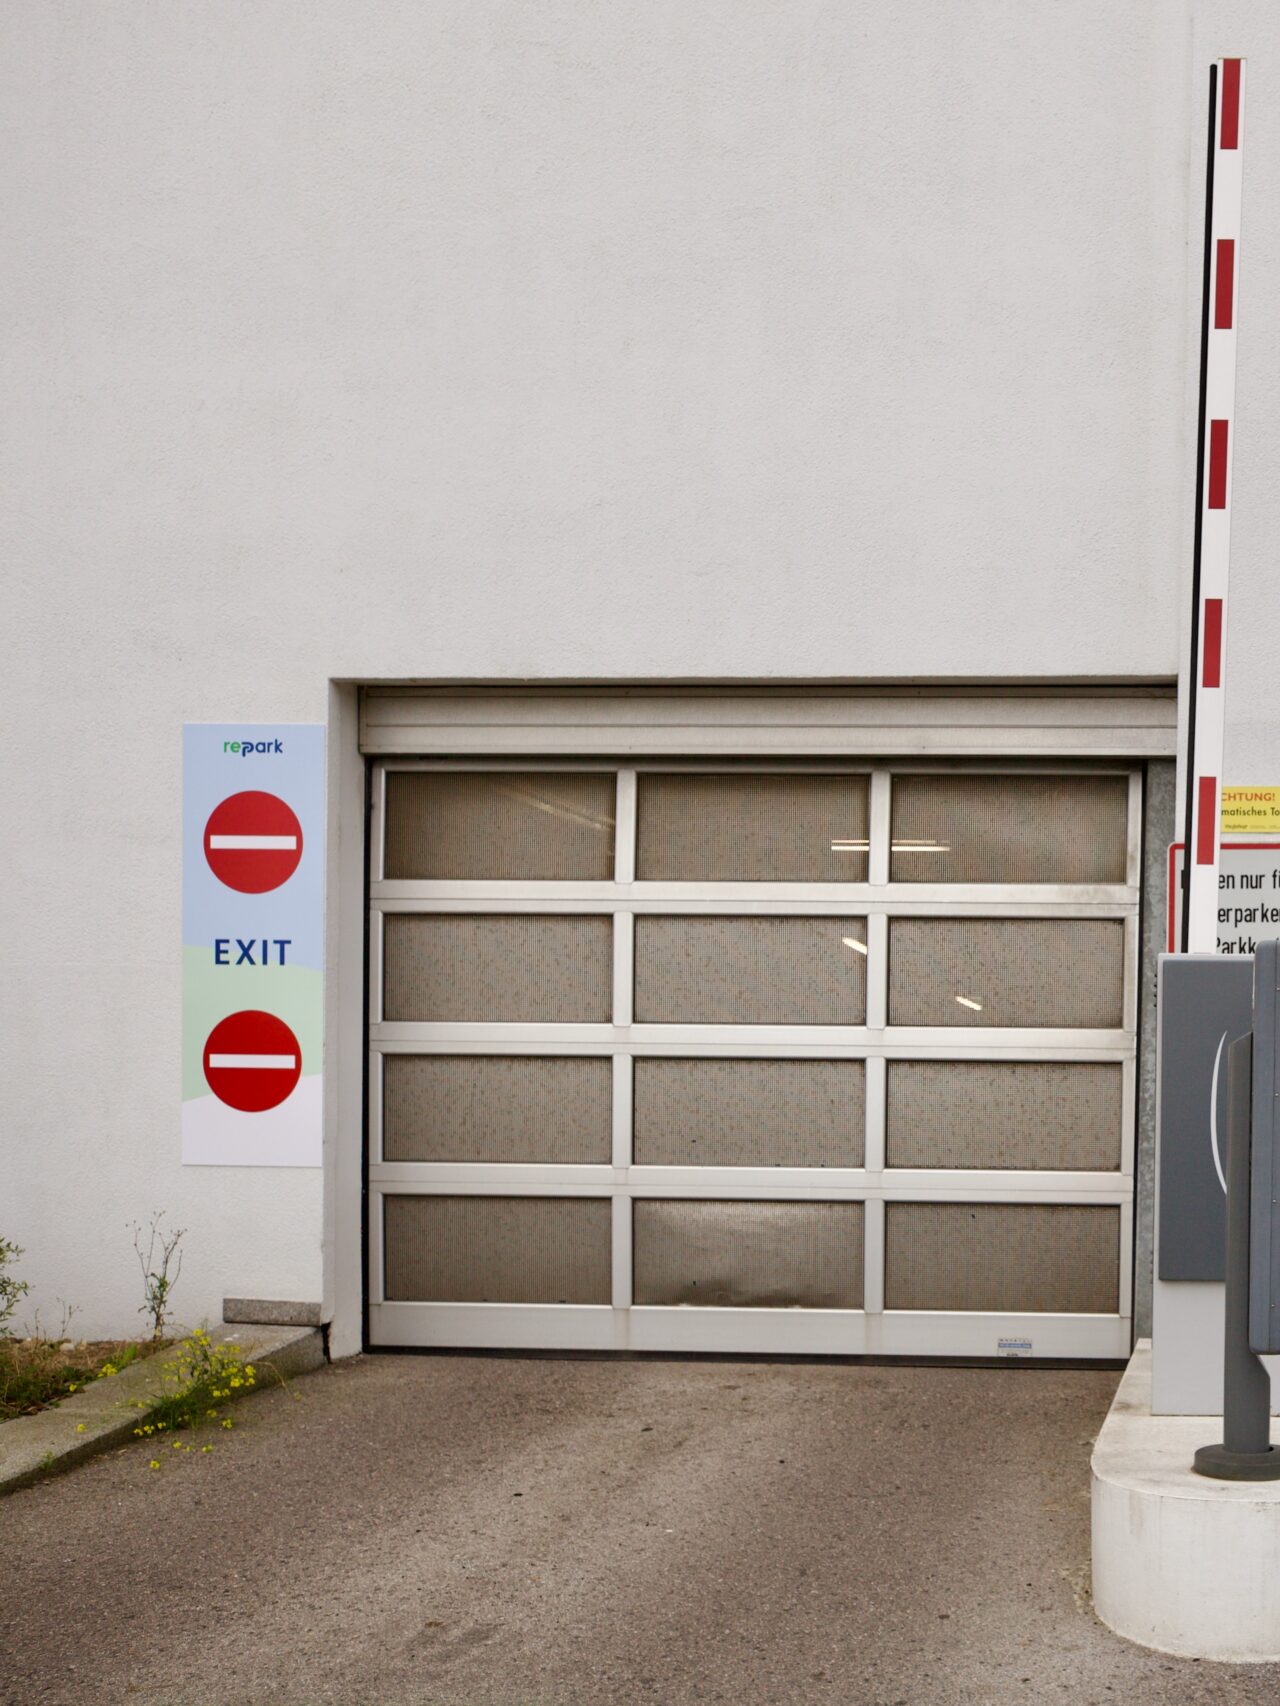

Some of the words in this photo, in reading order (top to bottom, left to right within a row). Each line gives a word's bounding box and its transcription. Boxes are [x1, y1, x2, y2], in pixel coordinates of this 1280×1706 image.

[223, 738, 284, 758] repark
[1221, 792, 1276, 802] CHTUNG!
[1221, 805, 1267, 816] matisches
[1240, 873, 1265, 889] nur
[214, 938, 292, 966] EXIT
